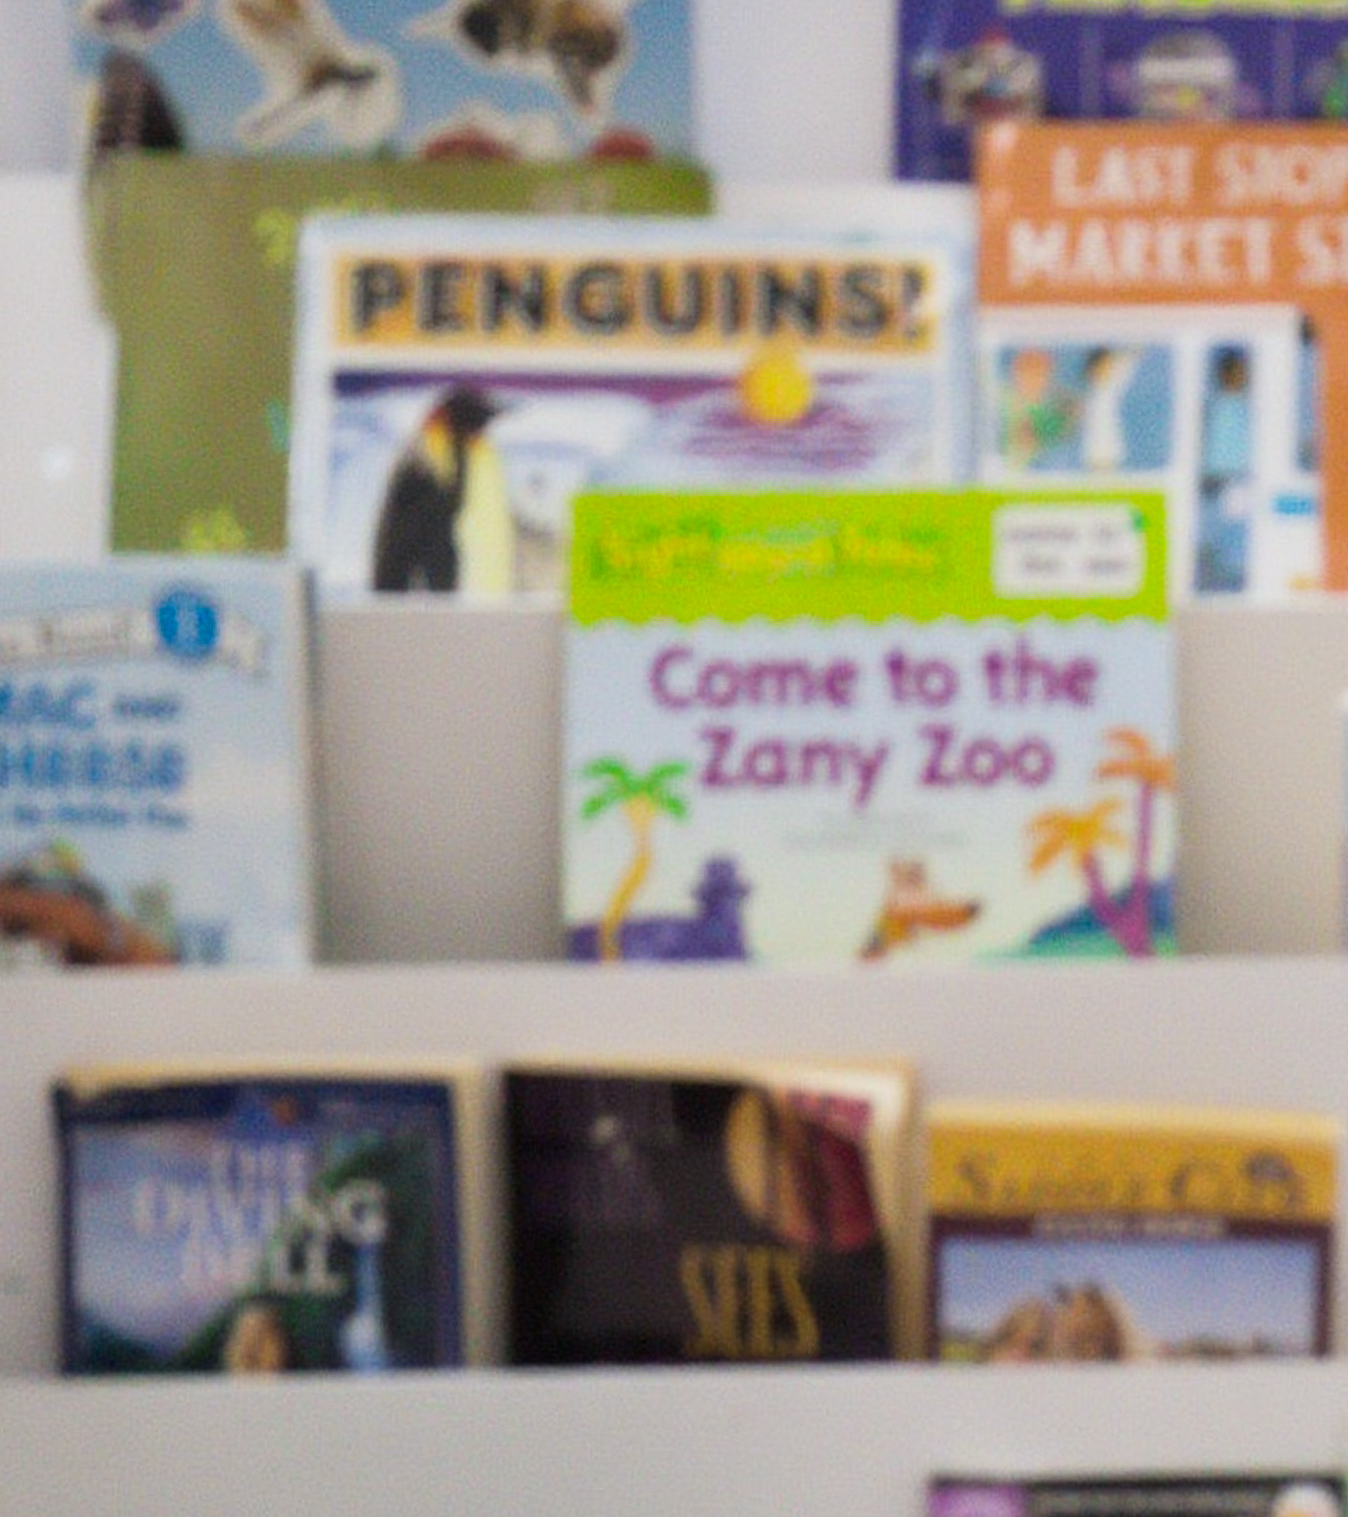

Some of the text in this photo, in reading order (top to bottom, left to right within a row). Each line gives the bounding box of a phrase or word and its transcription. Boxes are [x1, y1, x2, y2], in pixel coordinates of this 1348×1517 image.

[1051, 144, 1196, 208] LAST
[1008, 218, 1274, 286] MARKET
[349, 259, 931, 341] PENGUINS!
[649, 637, 1101, 710] Come to the
[698, 723, 1056, 813] Zany Zoo
[130, 1173, 389, 1247] DIVING
